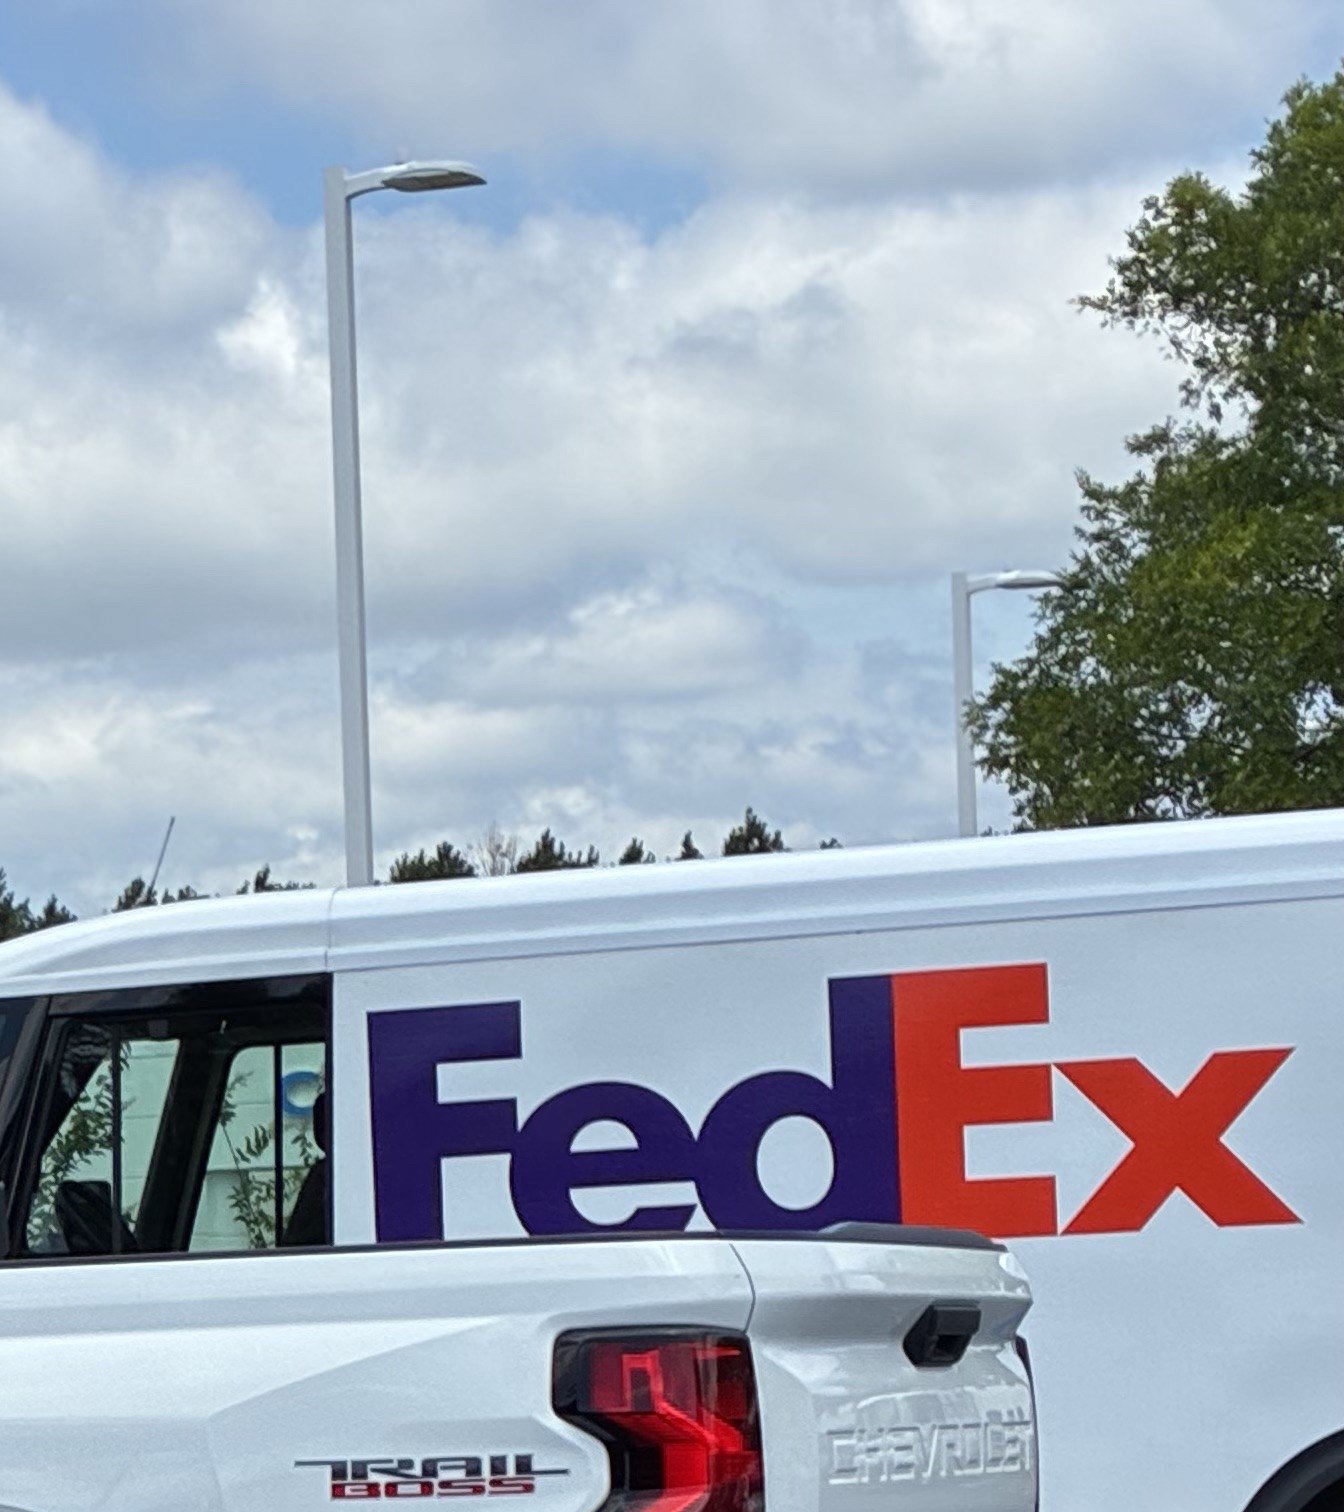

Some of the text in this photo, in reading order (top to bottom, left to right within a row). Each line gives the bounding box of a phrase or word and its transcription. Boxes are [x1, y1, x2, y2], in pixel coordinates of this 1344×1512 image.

[367, 963, 1304, 1242] FedEx
[294, 1454, 569, 1480] TRAIL
[331, 1477, 535, 1499] BOSS
